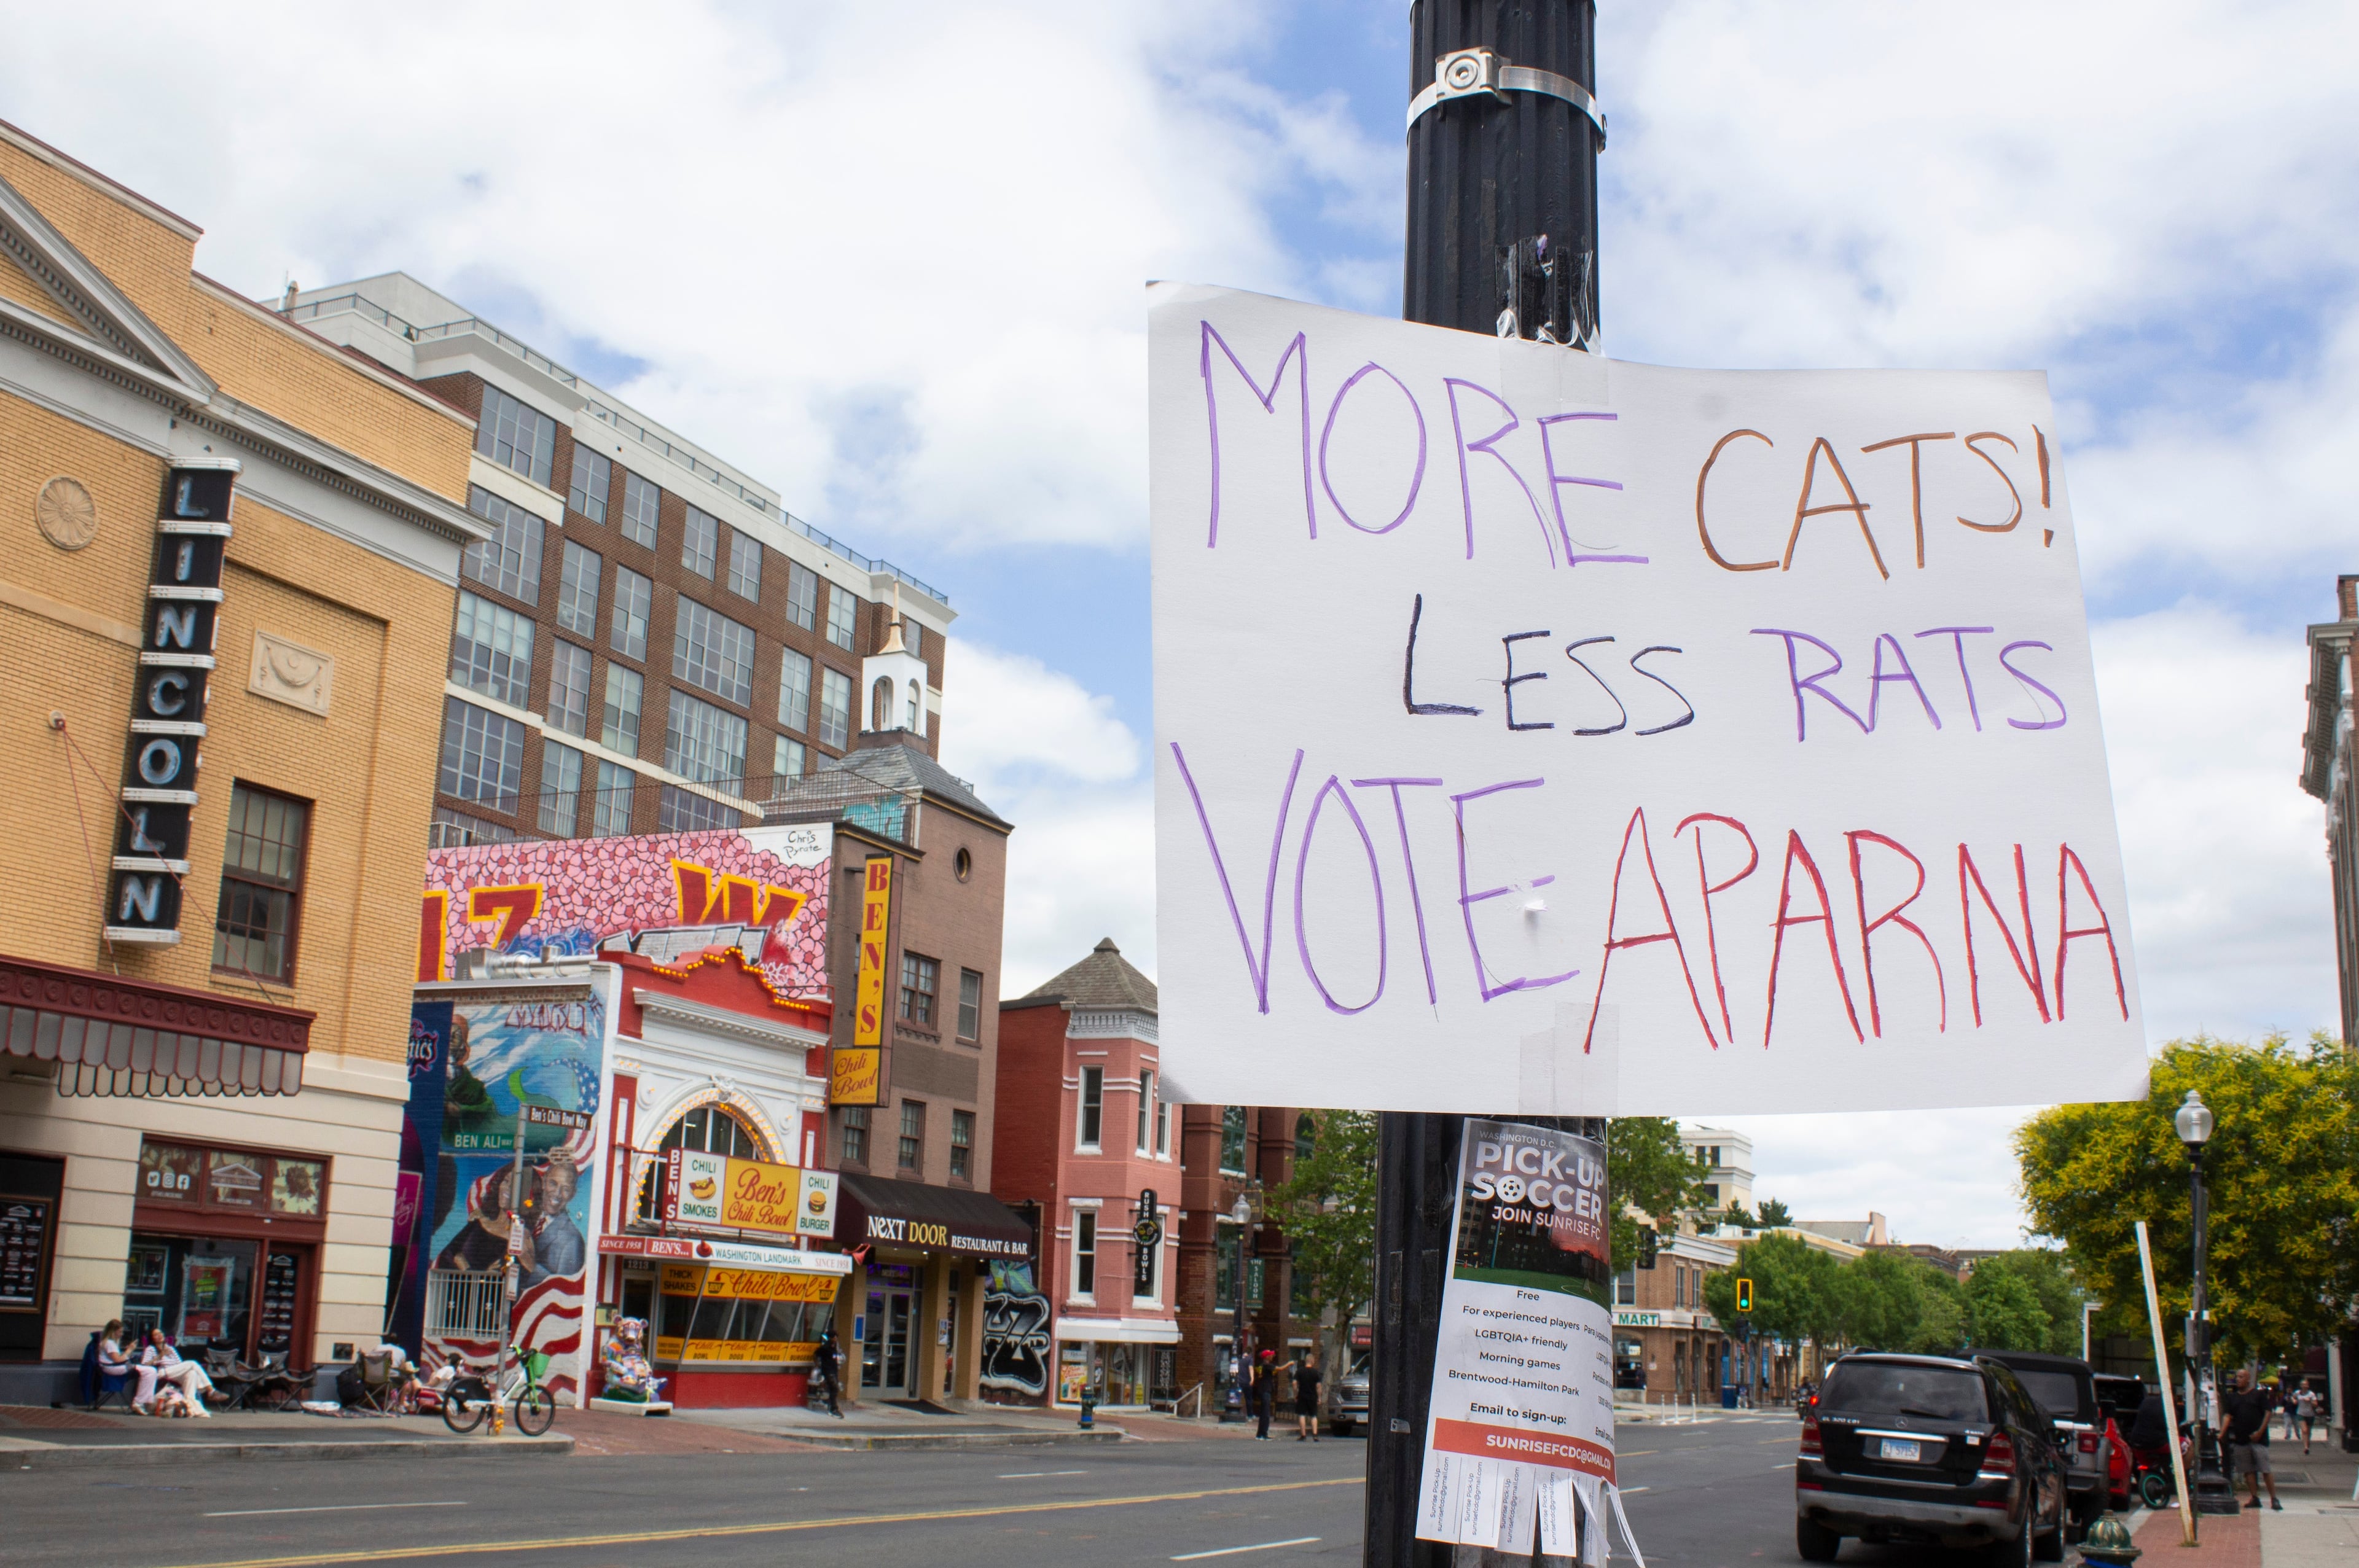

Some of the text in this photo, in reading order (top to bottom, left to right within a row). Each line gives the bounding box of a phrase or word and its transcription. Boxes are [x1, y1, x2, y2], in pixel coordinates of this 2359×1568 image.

[1200, 319, 2055, 581] MORE CATS!
[1401, 593, 2067, 742] LESS RATS
[119, 475, 209, 924] LINCOLN
[788, 830, 816, 844] Chris
[783, 844, 822, 859] Pyrate
[1170, 741, 2130, 1055] VOTE APARNA
[861, 863, 888, 1034] BEN'S
[834, 1052, 867, 1078] Chili
[832, 1067, 877, 1099] Bowl
[531, 1107, 588, 1129] Ben's Chili Bowl Way
[455, 1135, 478, 1148] BEN
[483, 1135, 501, 1149] ALI
[1479, 1130, 1556, 1149] WASHINGTON D.C.
[692, 1160, 716, 1173] CHILI
[1476, 1141, 1603, 1192] PICK-UP
[666, 1149, 680, 1219] BEN'S
[735, 1168, 786, 1206] Ben's
[808, 1176, 829, 1189] CHILI
[1471, 1171, 1602, 1225] SOCCER
[683, 1203, 718, 1219] SMOKES
[727, 1201, 792, 1227] Chili Bowl
[800, 1217, 830, 1231] BURGER
[1492, 1206, 1601, 1241] JOIN SUNRISE FC
[601, 1239, 643, 1249] SINCE 1958
[909, 1222, 947, 1246] DOOR
[951, 1235, 1003, 1252] RESTAURANT
[1004, 1241, 1011, 1254] &
[1012, 1242, 1028, 1255] BAR
[627, 1260, 649, 1269] 1213
[715, 1248, 802, 1266] WASHINGTON LANDMARK
[815, 1258, 835, 1268] SINCE
[669, 1269, 693, 1279] THICK
[731, 1272, 819, 1297] Chili Bowl
[663, 1281, 696, 1292] SHAKES
[1517, 1290, 1539, 1301] Free
[1463, 1305, 1580, 1331] For experienced players
[1619, 1314, 1658, 1325] MART
[1475, 1328, 1568, 1351] LGBTQIA+ friendly
[1479, 1351, 1561, 1370] Morning games
[1448, 1369, 1580, 1396] Brentwood-Hamilton Park
[1470, 1402, 1567, 1425] Email to sign-up:
[1438, 1457, 1449, 1532] sunrisefcdc@gmail.com
[1472, 1462, 1482, 1535] sunrisefcdc@gmail.com
[1508, 1467, 1519, 1543] sunrisefcdc@gmail.com
